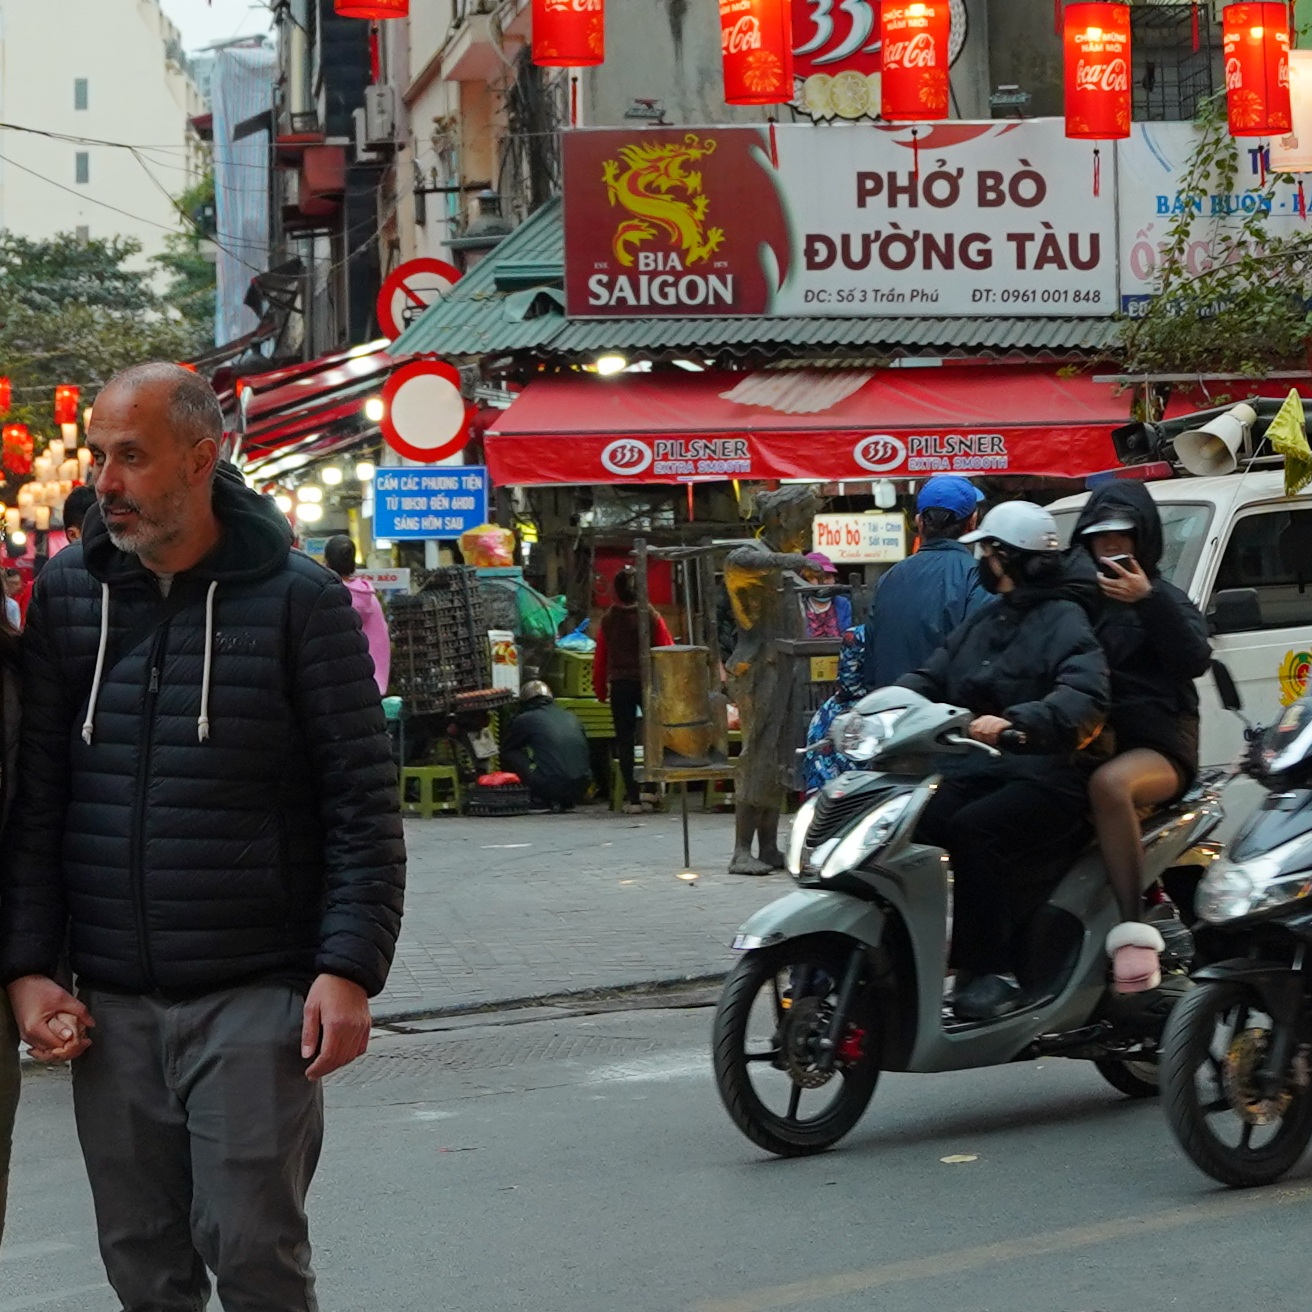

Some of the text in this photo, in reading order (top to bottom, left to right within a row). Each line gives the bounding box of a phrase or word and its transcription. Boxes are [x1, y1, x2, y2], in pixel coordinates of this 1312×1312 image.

[856, 158, 1047, 209] PHỞ BÒ
[804, 221, 1101, 272] ĐƯỜNG TÀU
[638, 251, 684, 272] BIA
[588, 274, 734, 306] SAIGON
[803, 287, 1101, 304] ĐC: Số 3 Trần Phú ĐT: 0961 001 848
[654, 439, 751, 460] PILSNER
[908, 434, 1007, 456] PILSNER
[654, 459, 751, 475] EXTRA SMOOTH
[908, 455, 1008, 471] EXTRA SMOOTH
[394, 514, 420, 530] SÁNG
[444, 517, 464, 530] SAU
